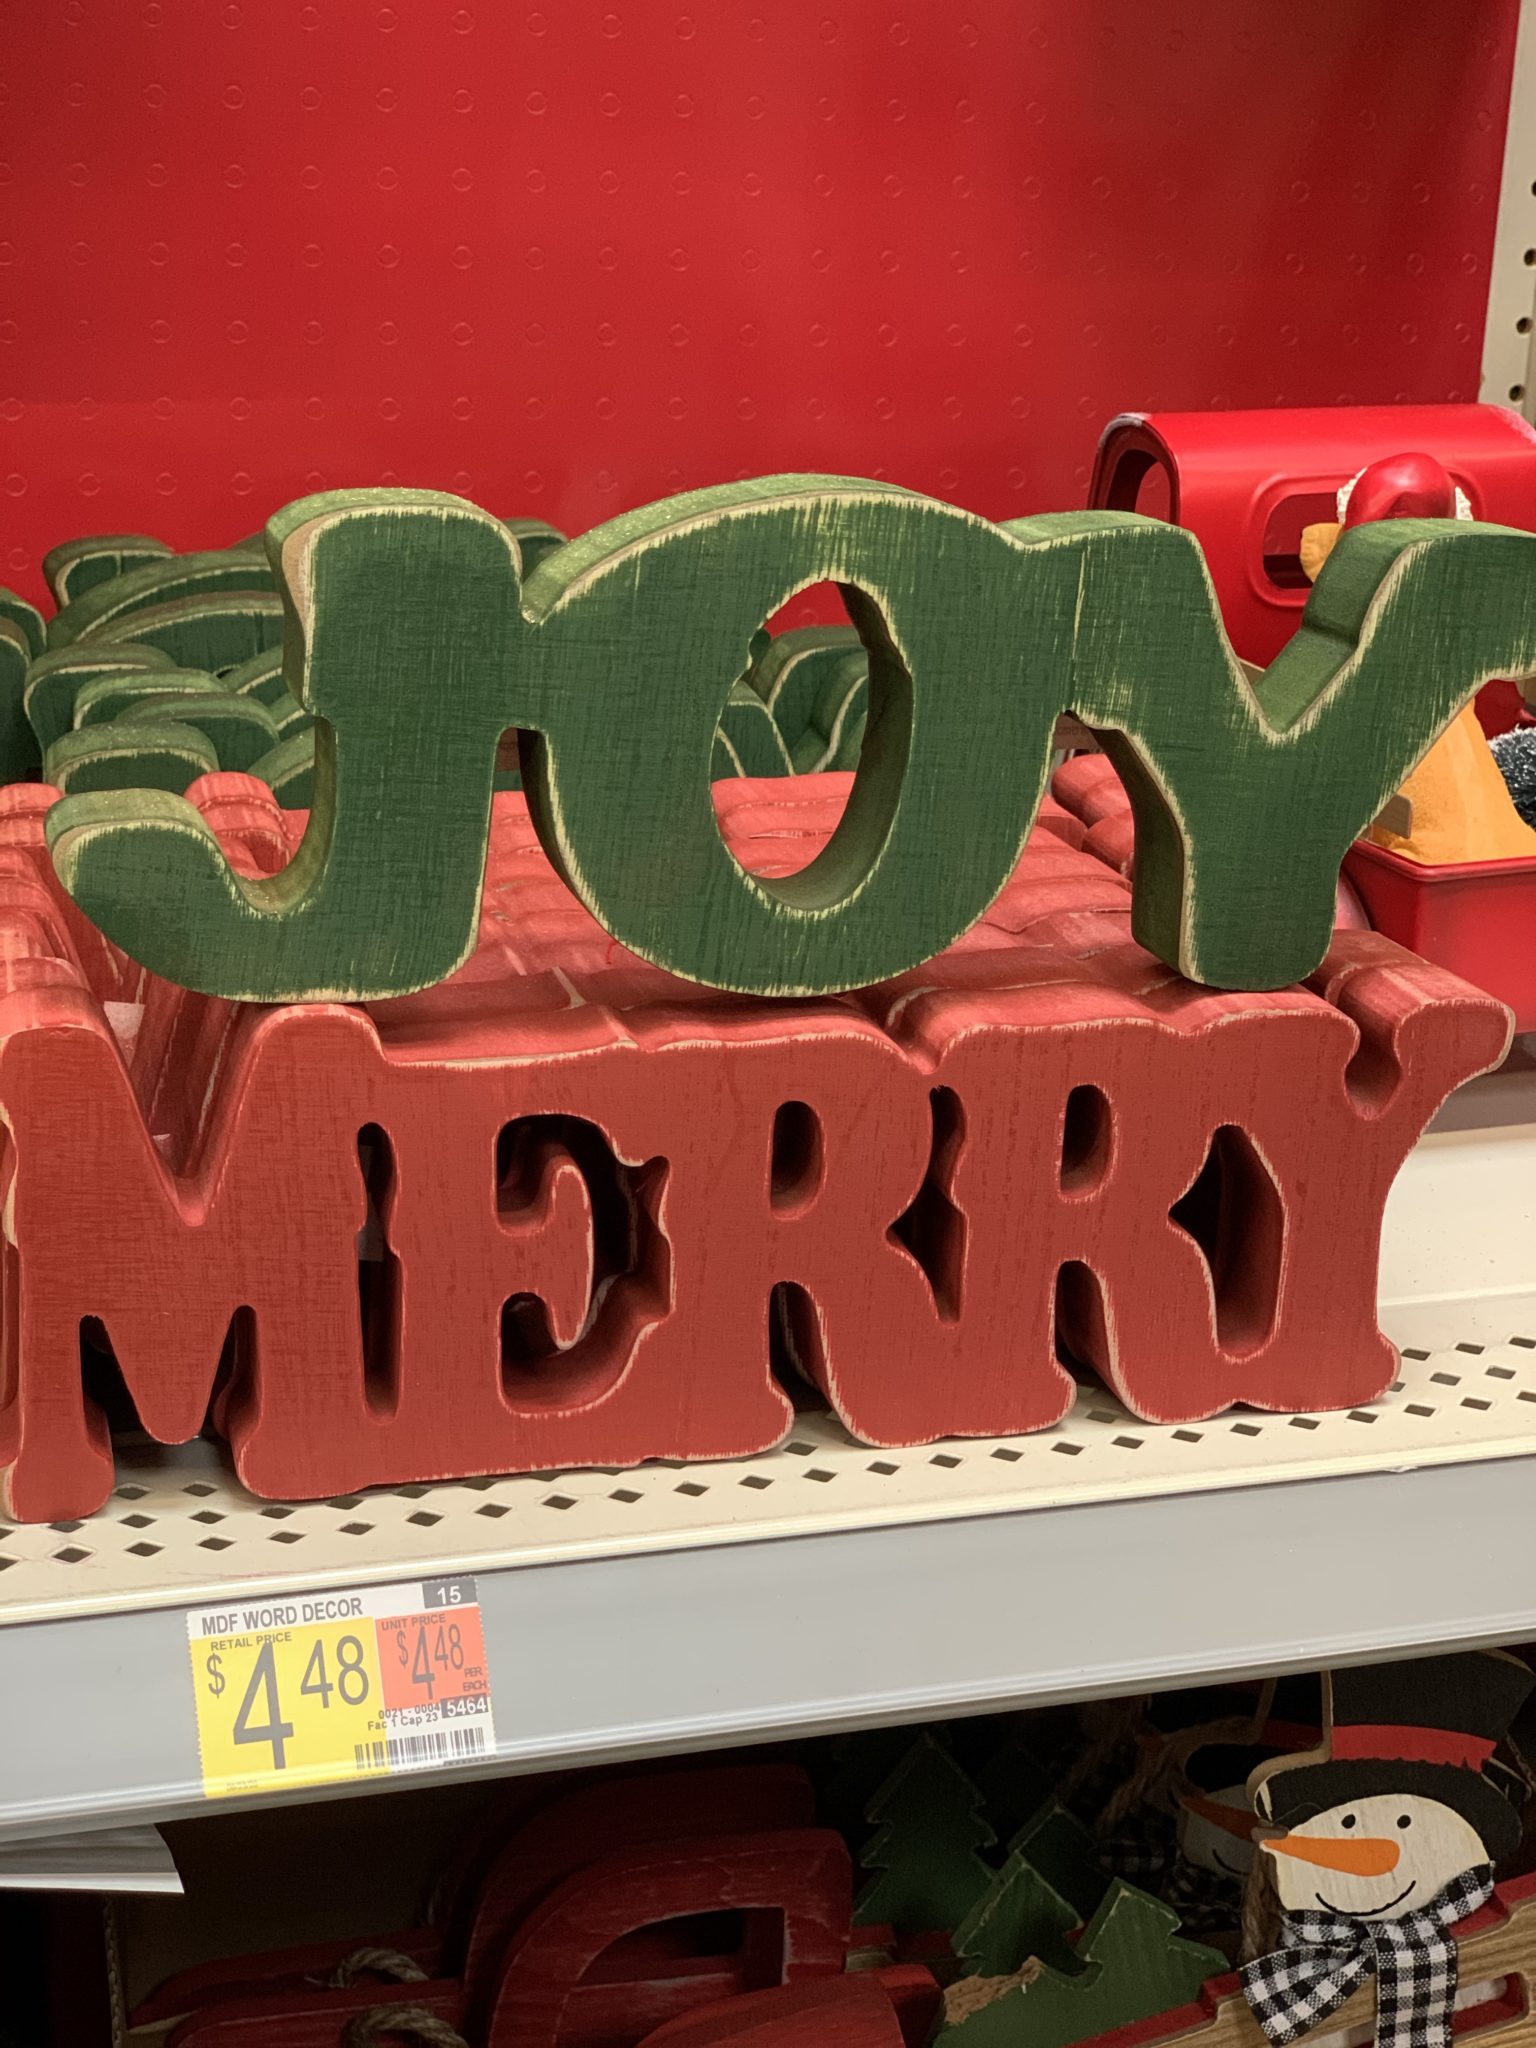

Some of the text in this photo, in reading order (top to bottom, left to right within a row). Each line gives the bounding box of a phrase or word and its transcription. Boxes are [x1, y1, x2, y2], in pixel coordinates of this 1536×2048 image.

[46, 473, 1536, 1002] JOY
[0, 990, 1516, 1523] MERRY
[437, 1585, 462, 1605] 15
[201, 1597, 364, 1636] MDF WORD DECOR
[381, 1613, 446, 1631] UNIT PRICE
[210, 1632, 293, 1652] RETAIL PRICE
[464, 1667, 483, 1678] PER
[462, 1679, 488, 1692] EACH
[378, 1707, 403, 1719] 0021
[414, 1703, 440, 1715] 0004
[447, 1695, 487, 1717] 5464
[367, 1720, 388, 1731] Fac
[400, 1715, 423, 1727] Cap
[425, 1712, 439, 1723] 23
